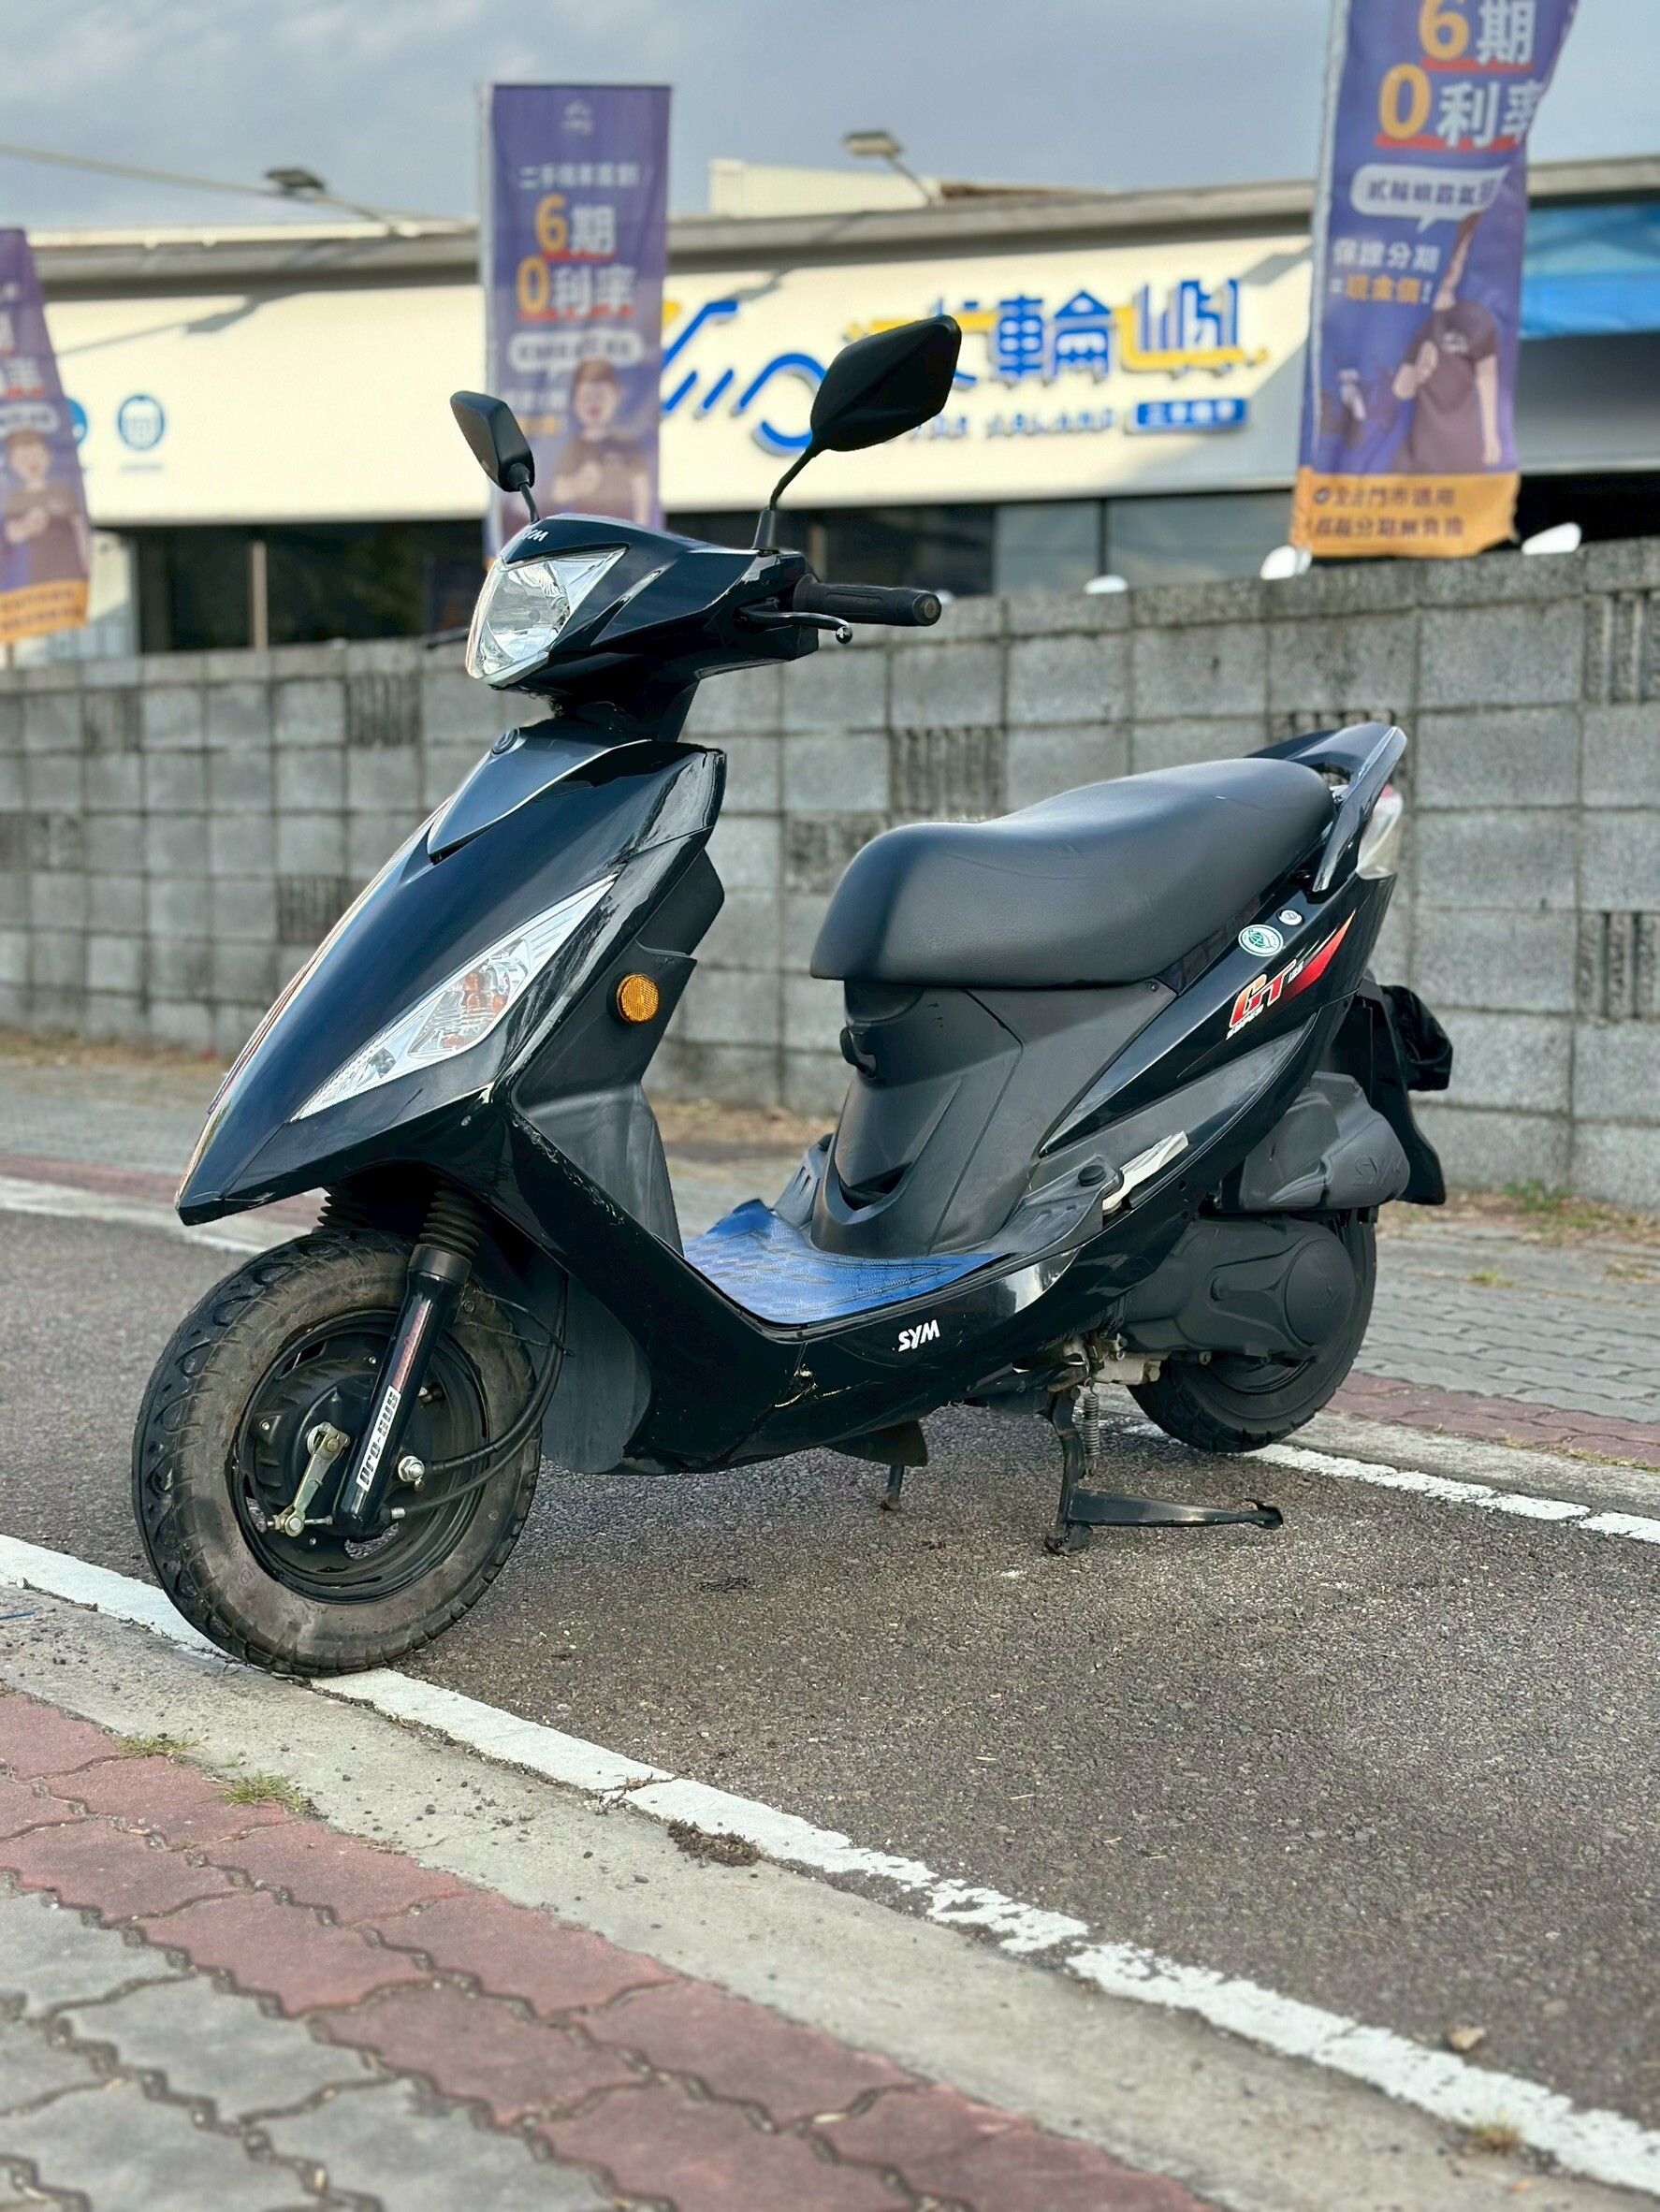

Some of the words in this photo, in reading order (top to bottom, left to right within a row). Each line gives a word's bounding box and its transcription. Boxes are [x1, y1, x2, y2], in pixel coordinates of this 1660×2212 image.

[1419, 0, 1536, 65] 6期
[534, 194, 616, 255] 6期
[1230, 959, 1297, 1028] GT
[898, 1319, 940, 1352] SYM
